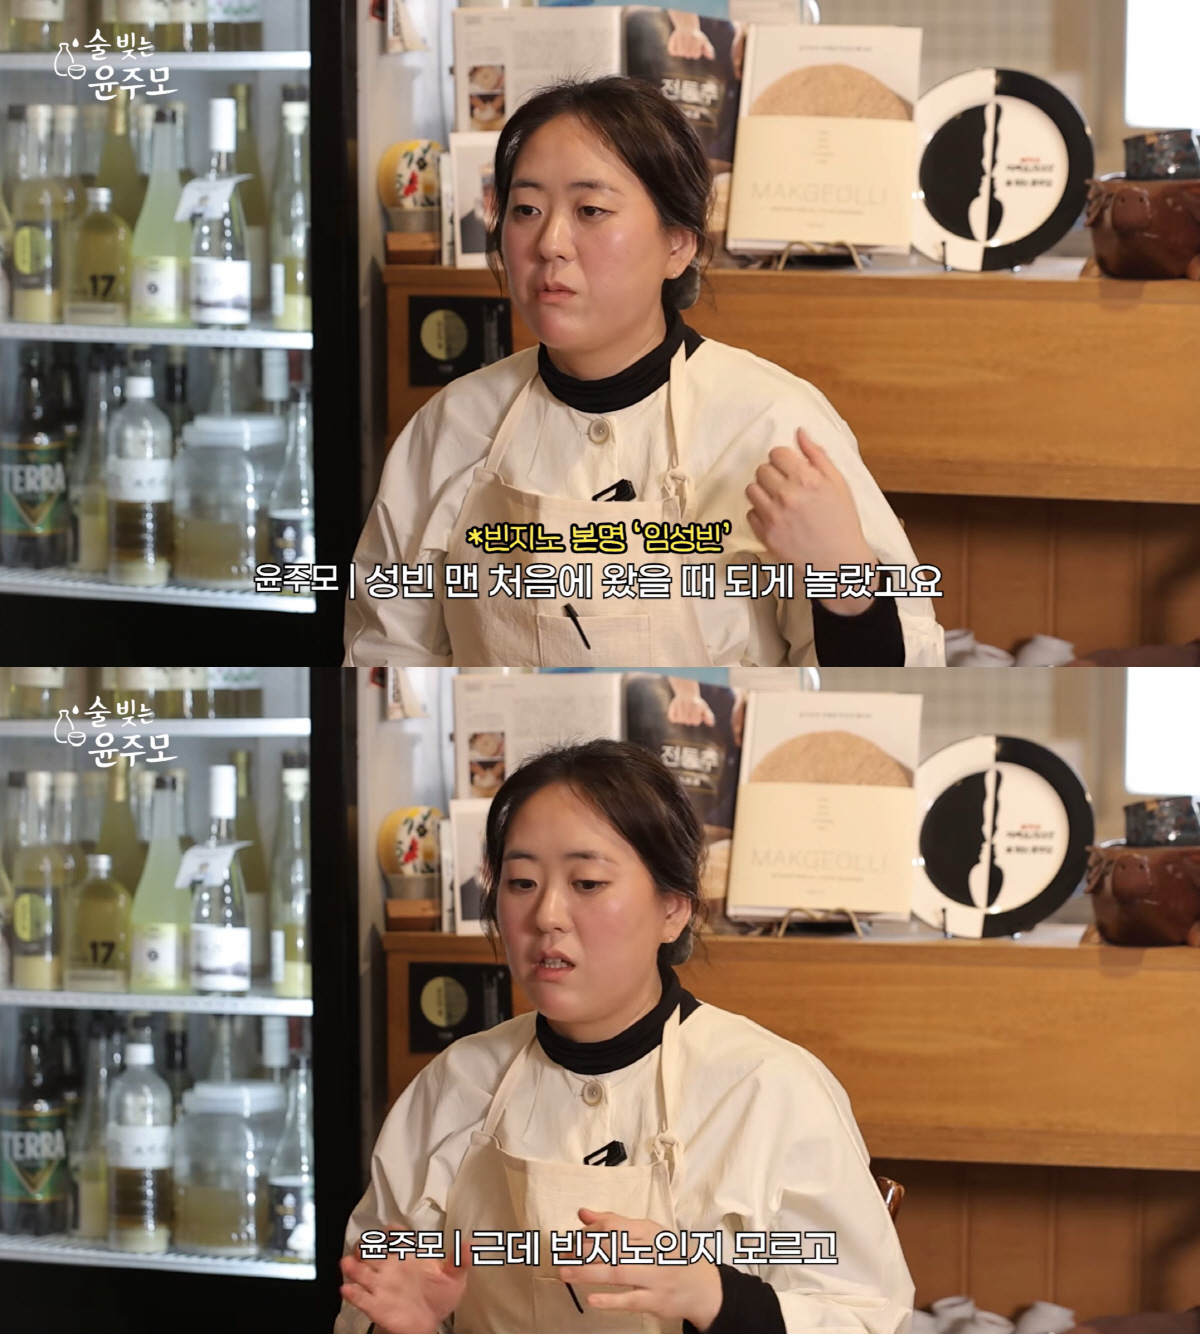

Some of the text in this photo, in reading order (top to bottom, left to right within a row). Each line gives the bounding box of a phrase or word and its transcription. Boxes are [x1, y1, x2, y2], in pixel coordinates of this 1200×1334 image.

[750, 181, 889, 206] MAKGEOLLI
[89, 274, 116, 297] 17
[1, 463, 66, 493] TERRA
[750, 848, 889, 873] MAKGEOLLI
[89, 941, 116, 964] 17
[1, 1130, 66, 1160] TERRA
